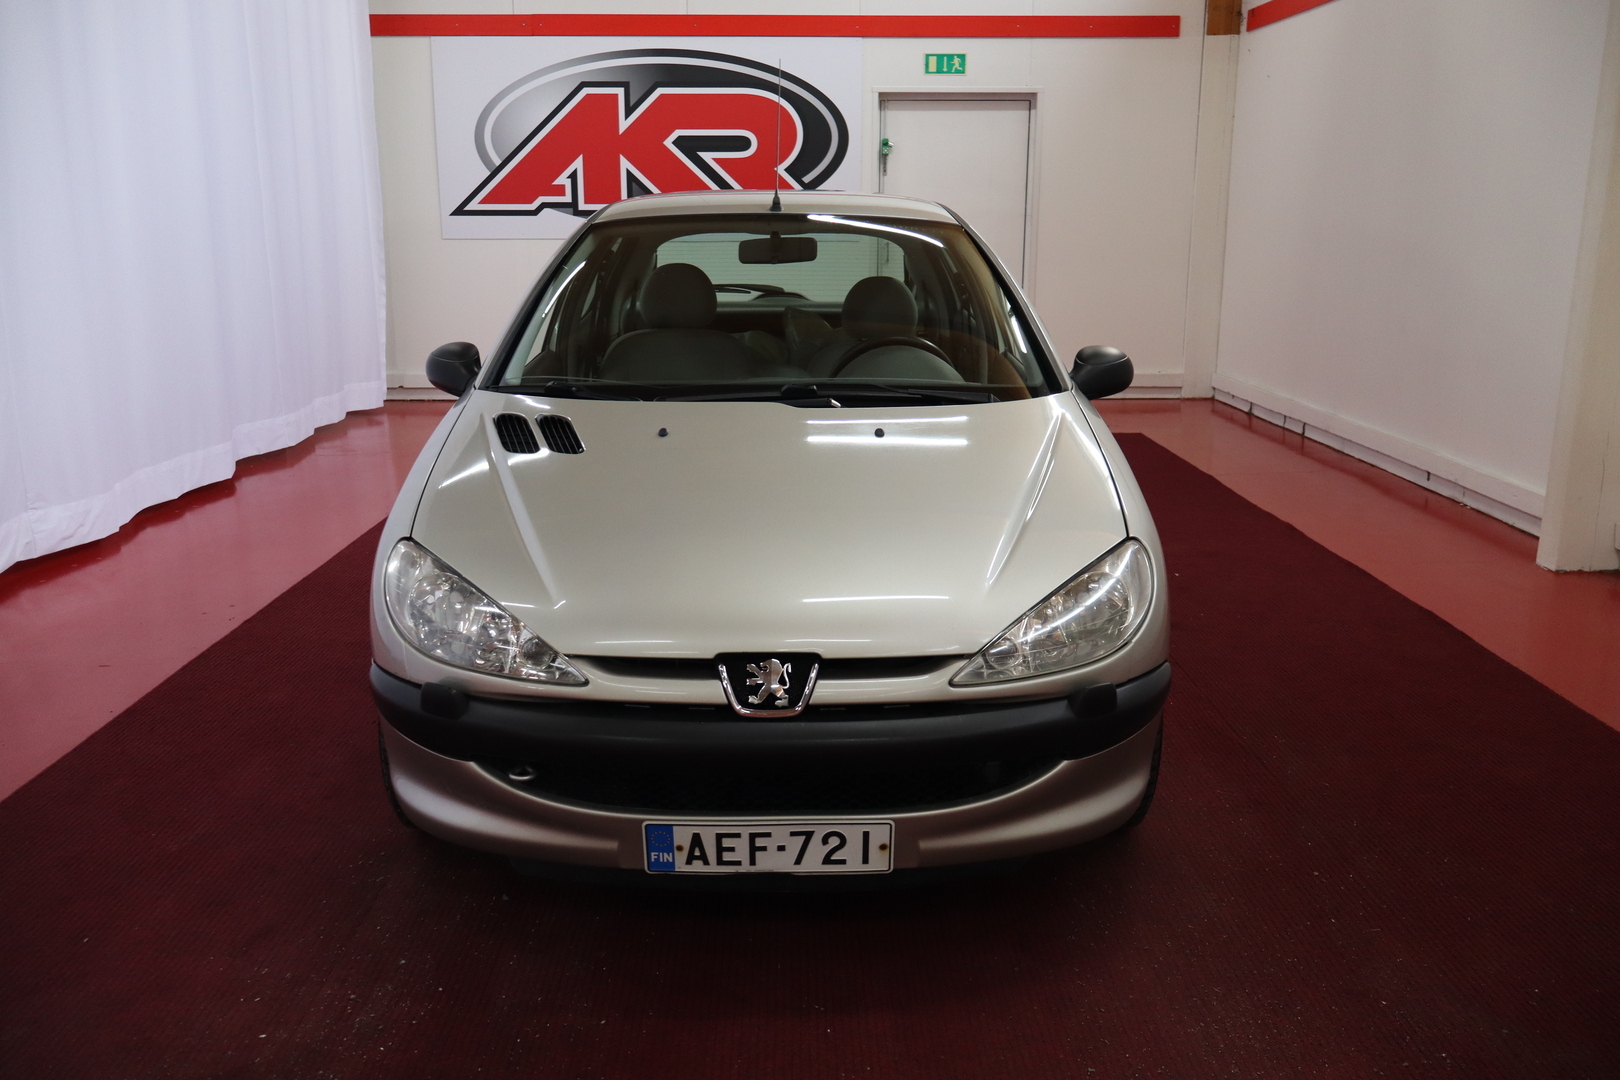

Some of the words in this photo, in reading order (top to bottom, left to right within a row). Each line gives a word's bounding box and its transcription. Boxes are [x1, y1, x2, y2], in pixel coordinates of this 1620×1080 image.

[450, 82, 808, 215] AKR
[650, 852, 674, 863] FIN
[684, 830, 870, 866] AEF-721
